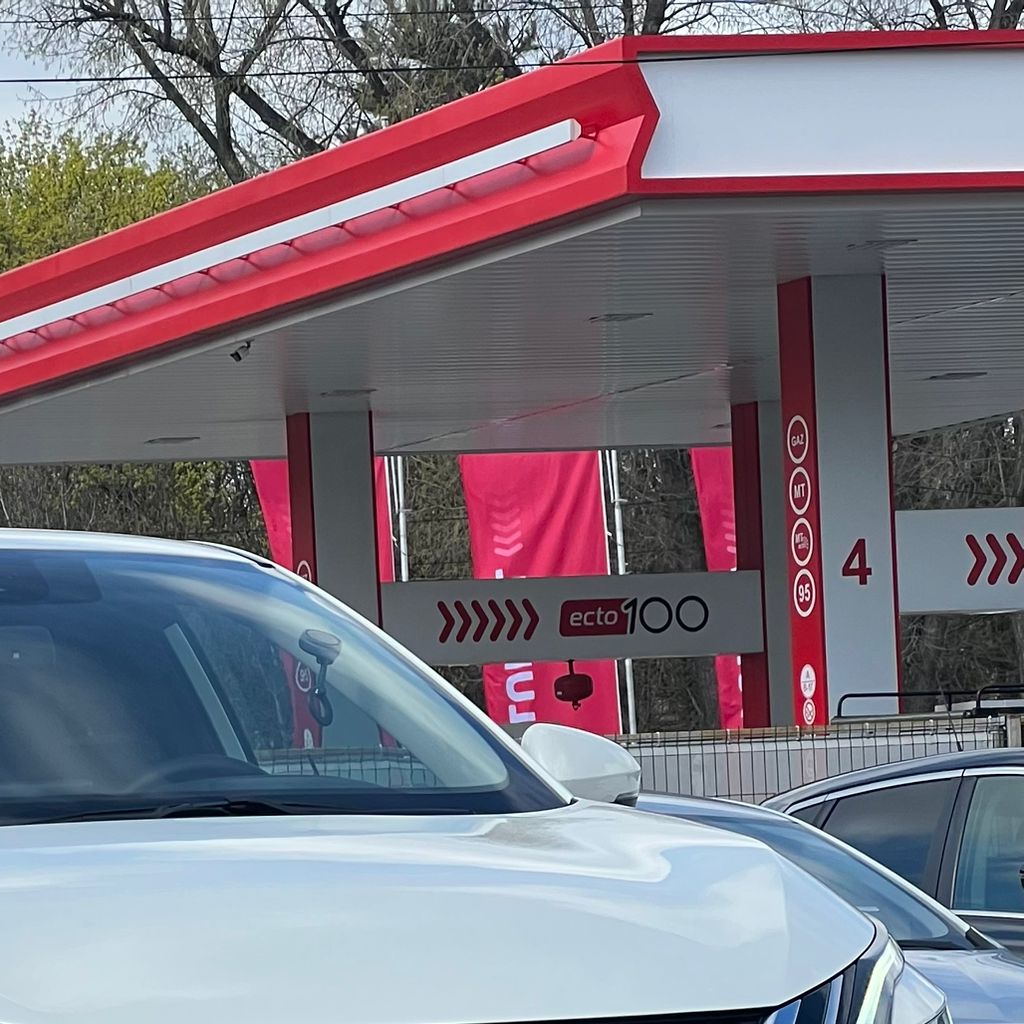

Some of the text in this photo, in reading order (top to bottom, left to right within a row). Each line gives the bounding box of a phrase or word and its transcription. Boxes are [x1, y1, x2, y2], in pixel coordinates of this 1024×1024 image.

[791, 433, 805, 447] GAZ
[794, 483, 806, 499] MT
[842, 538, 872, 585] 4
[798, 583, 811, 602] 95
